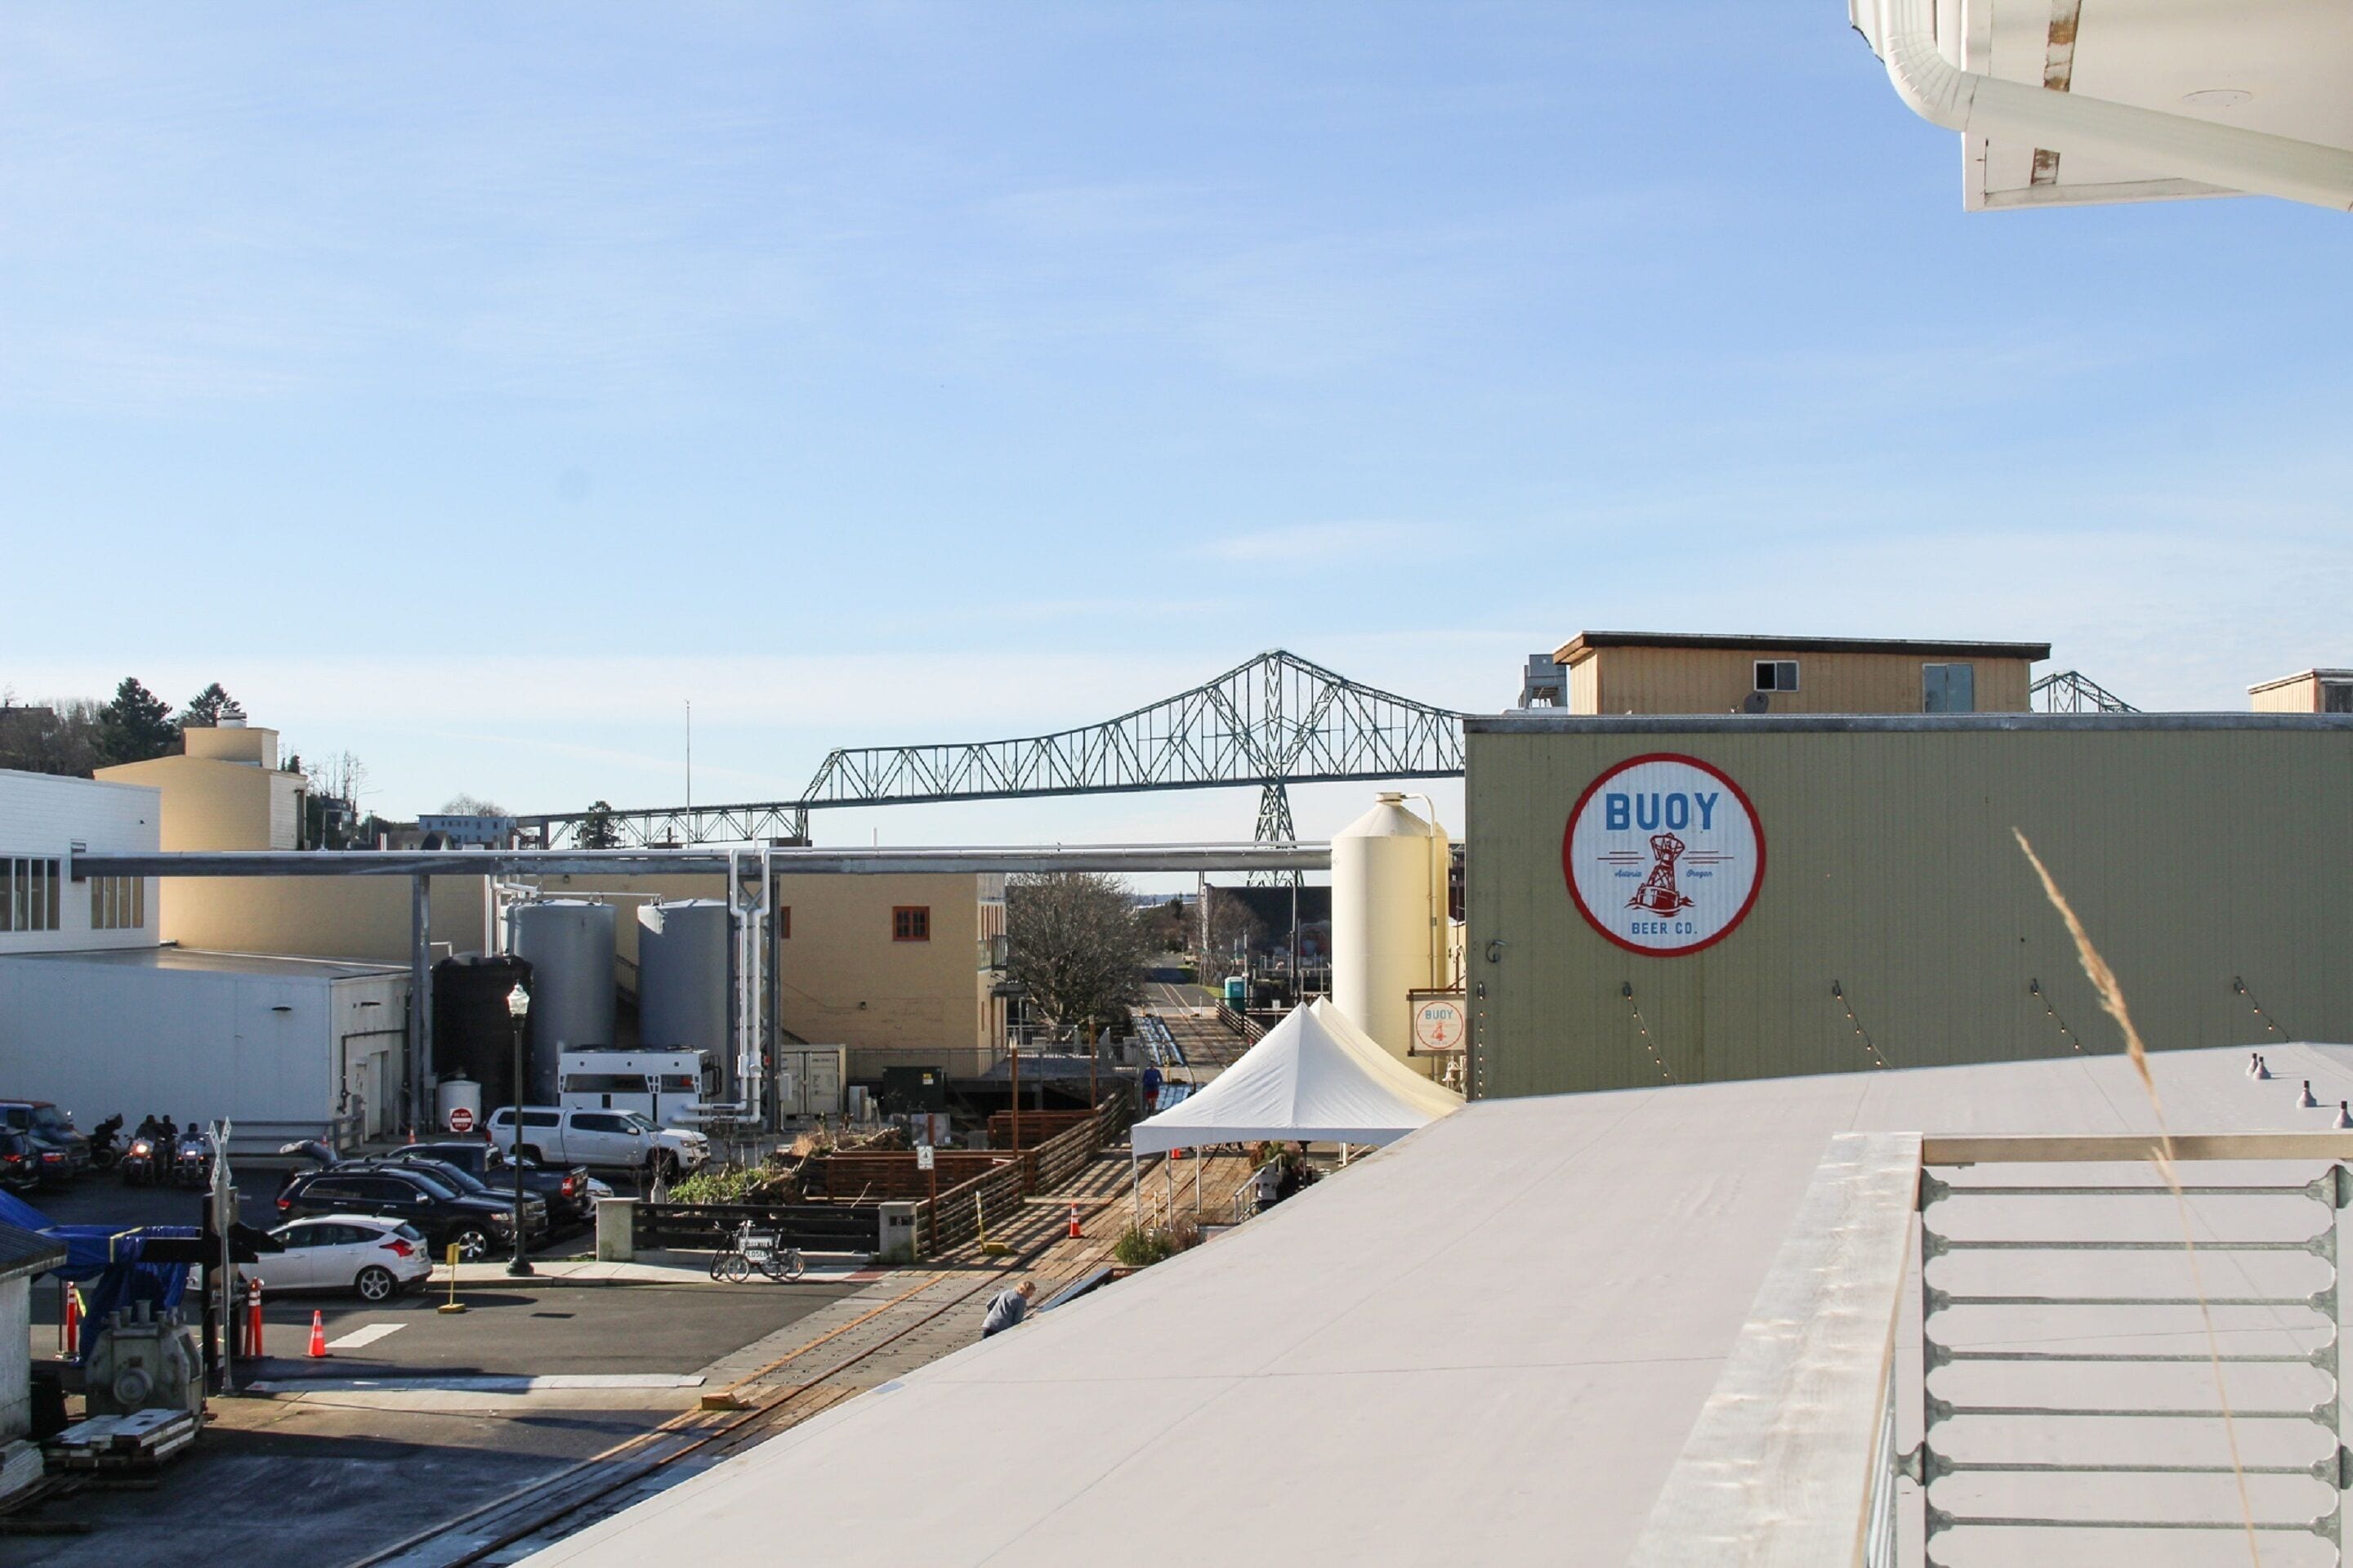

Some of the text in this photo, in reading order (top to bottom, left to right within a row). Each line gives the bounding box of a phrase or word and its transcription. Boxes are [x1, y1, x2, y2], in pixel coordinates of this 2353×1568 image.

[1605, 793, 1718, 830] BUOY
[1614, 869, 1712, 878] Astoria Oregon
[1632, 922, 1698, 935] BEER CO.
[1425, 1009, 1453, 1019] BUOY
